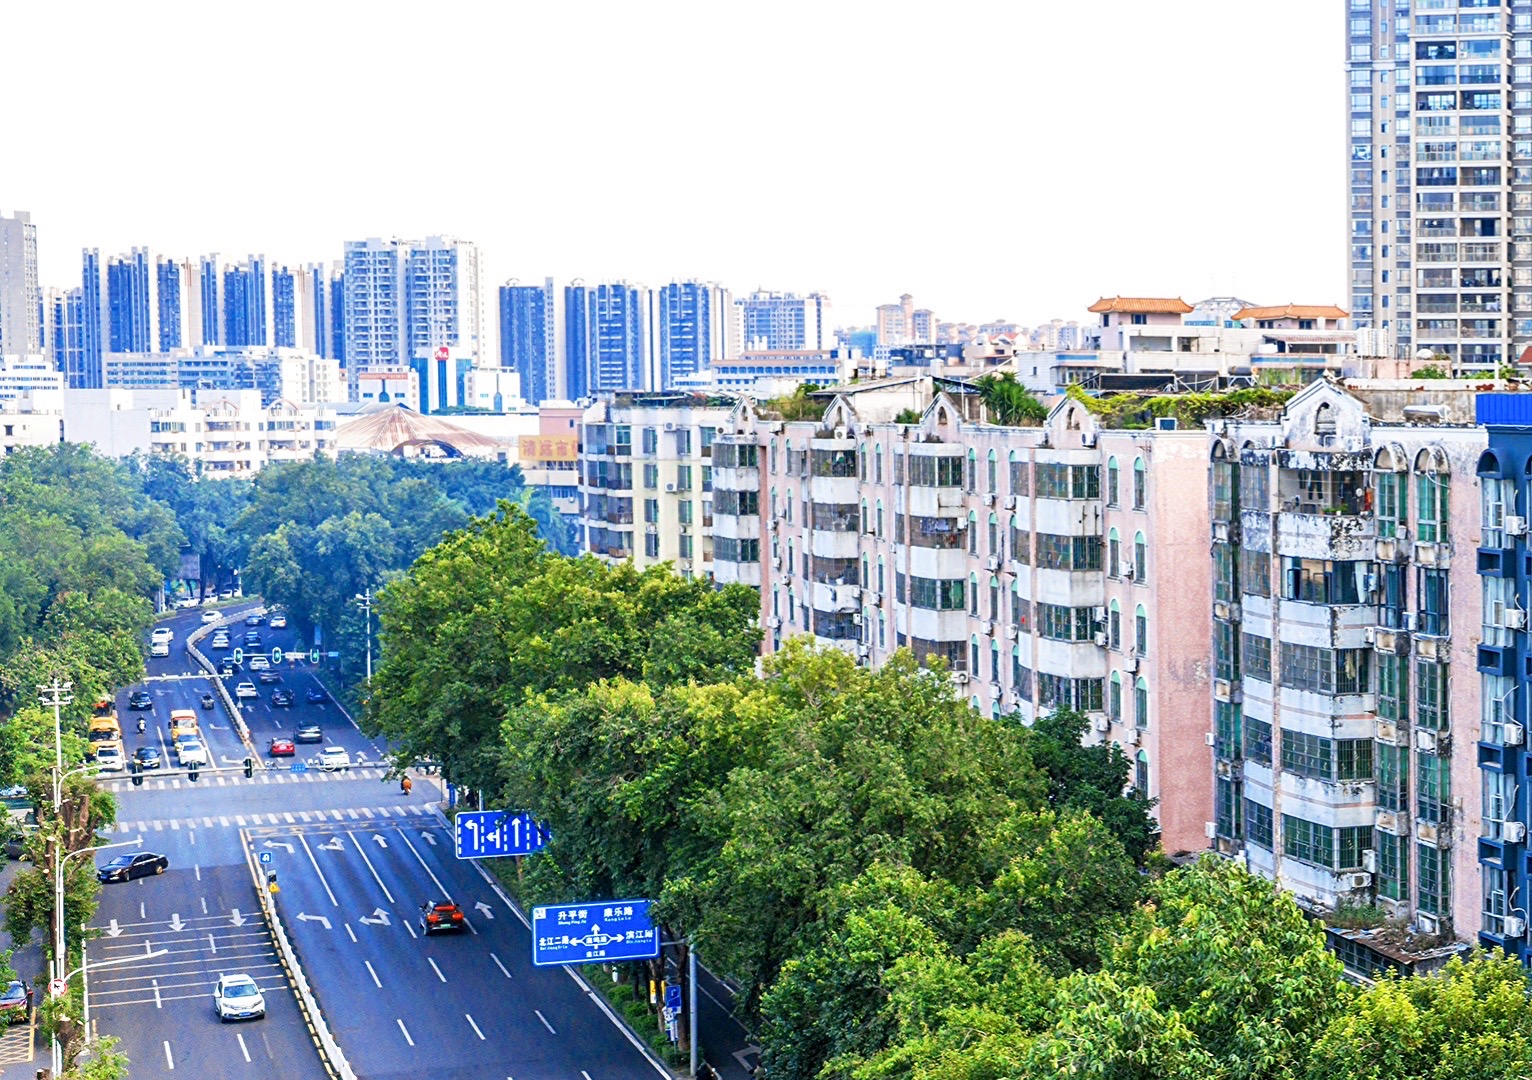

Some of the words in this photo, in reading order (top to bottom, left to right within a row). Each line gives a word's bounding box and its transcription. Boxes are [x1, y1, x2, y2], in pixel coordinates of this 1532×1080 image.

[522, 439, 577, 457] 清远市
[557, 909, 588, 920] 升平街
[603, 906, 633, 917] 康乐路
[625, 929, 654, 940] 滨江路
[539, 935, 570, 947] 北江二路
